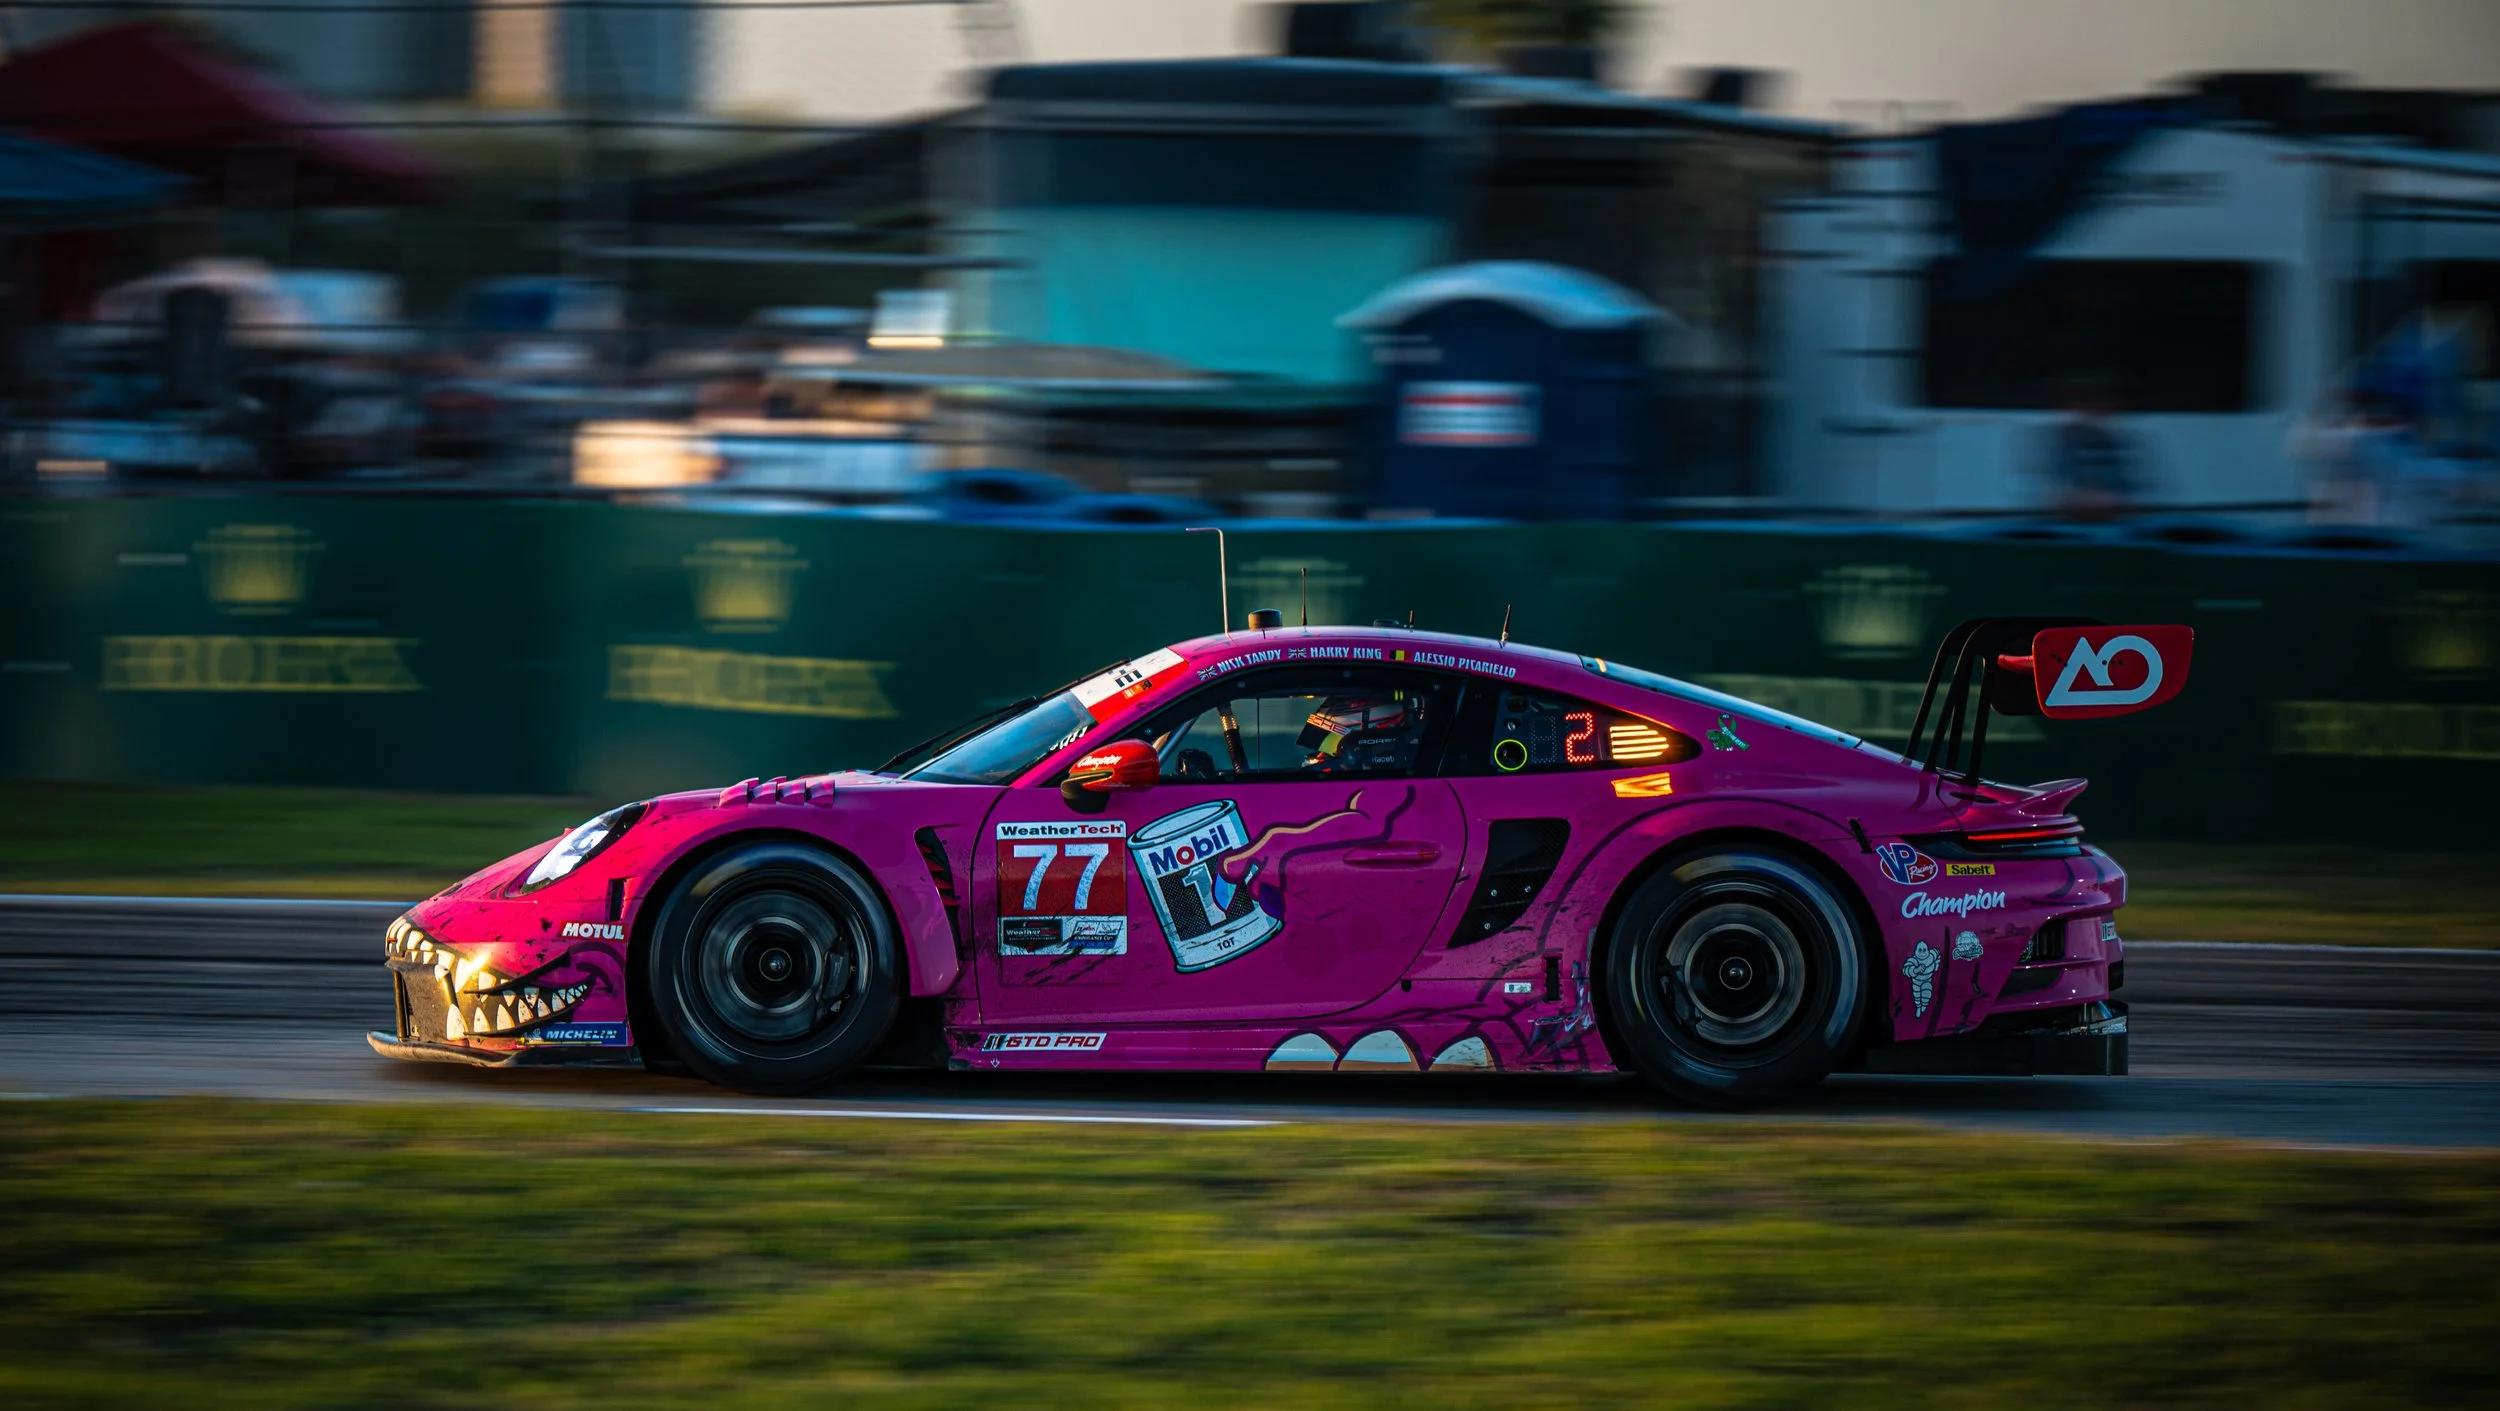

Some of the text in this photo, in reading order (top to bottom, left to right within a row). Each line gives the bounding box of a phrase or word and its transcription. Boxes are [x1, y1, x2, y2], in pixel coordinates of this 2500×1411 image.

[1217, 649, 1282, 672] NICK TANDY
[1310, 646, 1382, 660] HARRY KING
[1414, 651, 1516, 679] ALESSIO PICARIELLO
[1564, 712, 1594, 763] 2
[1001, 824, 1122, 836] WeatherTech
[1148, 823, 1231, 876] Mobil
[1876, 843, 1917, 885] VP
[1908, 863, 1937, 880] Racing
[1951, 864, 1991, 875] Sabelt
[1013, 843, 1109, 910] 77
[1181, 861, 1227, 927] 1
[1901, 888, 2005, 918] Champion
[561, 922, 625, 940] MOTUL
[1217, 936, 1236, 951] 1QT
[546, 1030, 617, 1039] MICHELIN
[1006, 1035, 1101, 1048] GTD PRO
